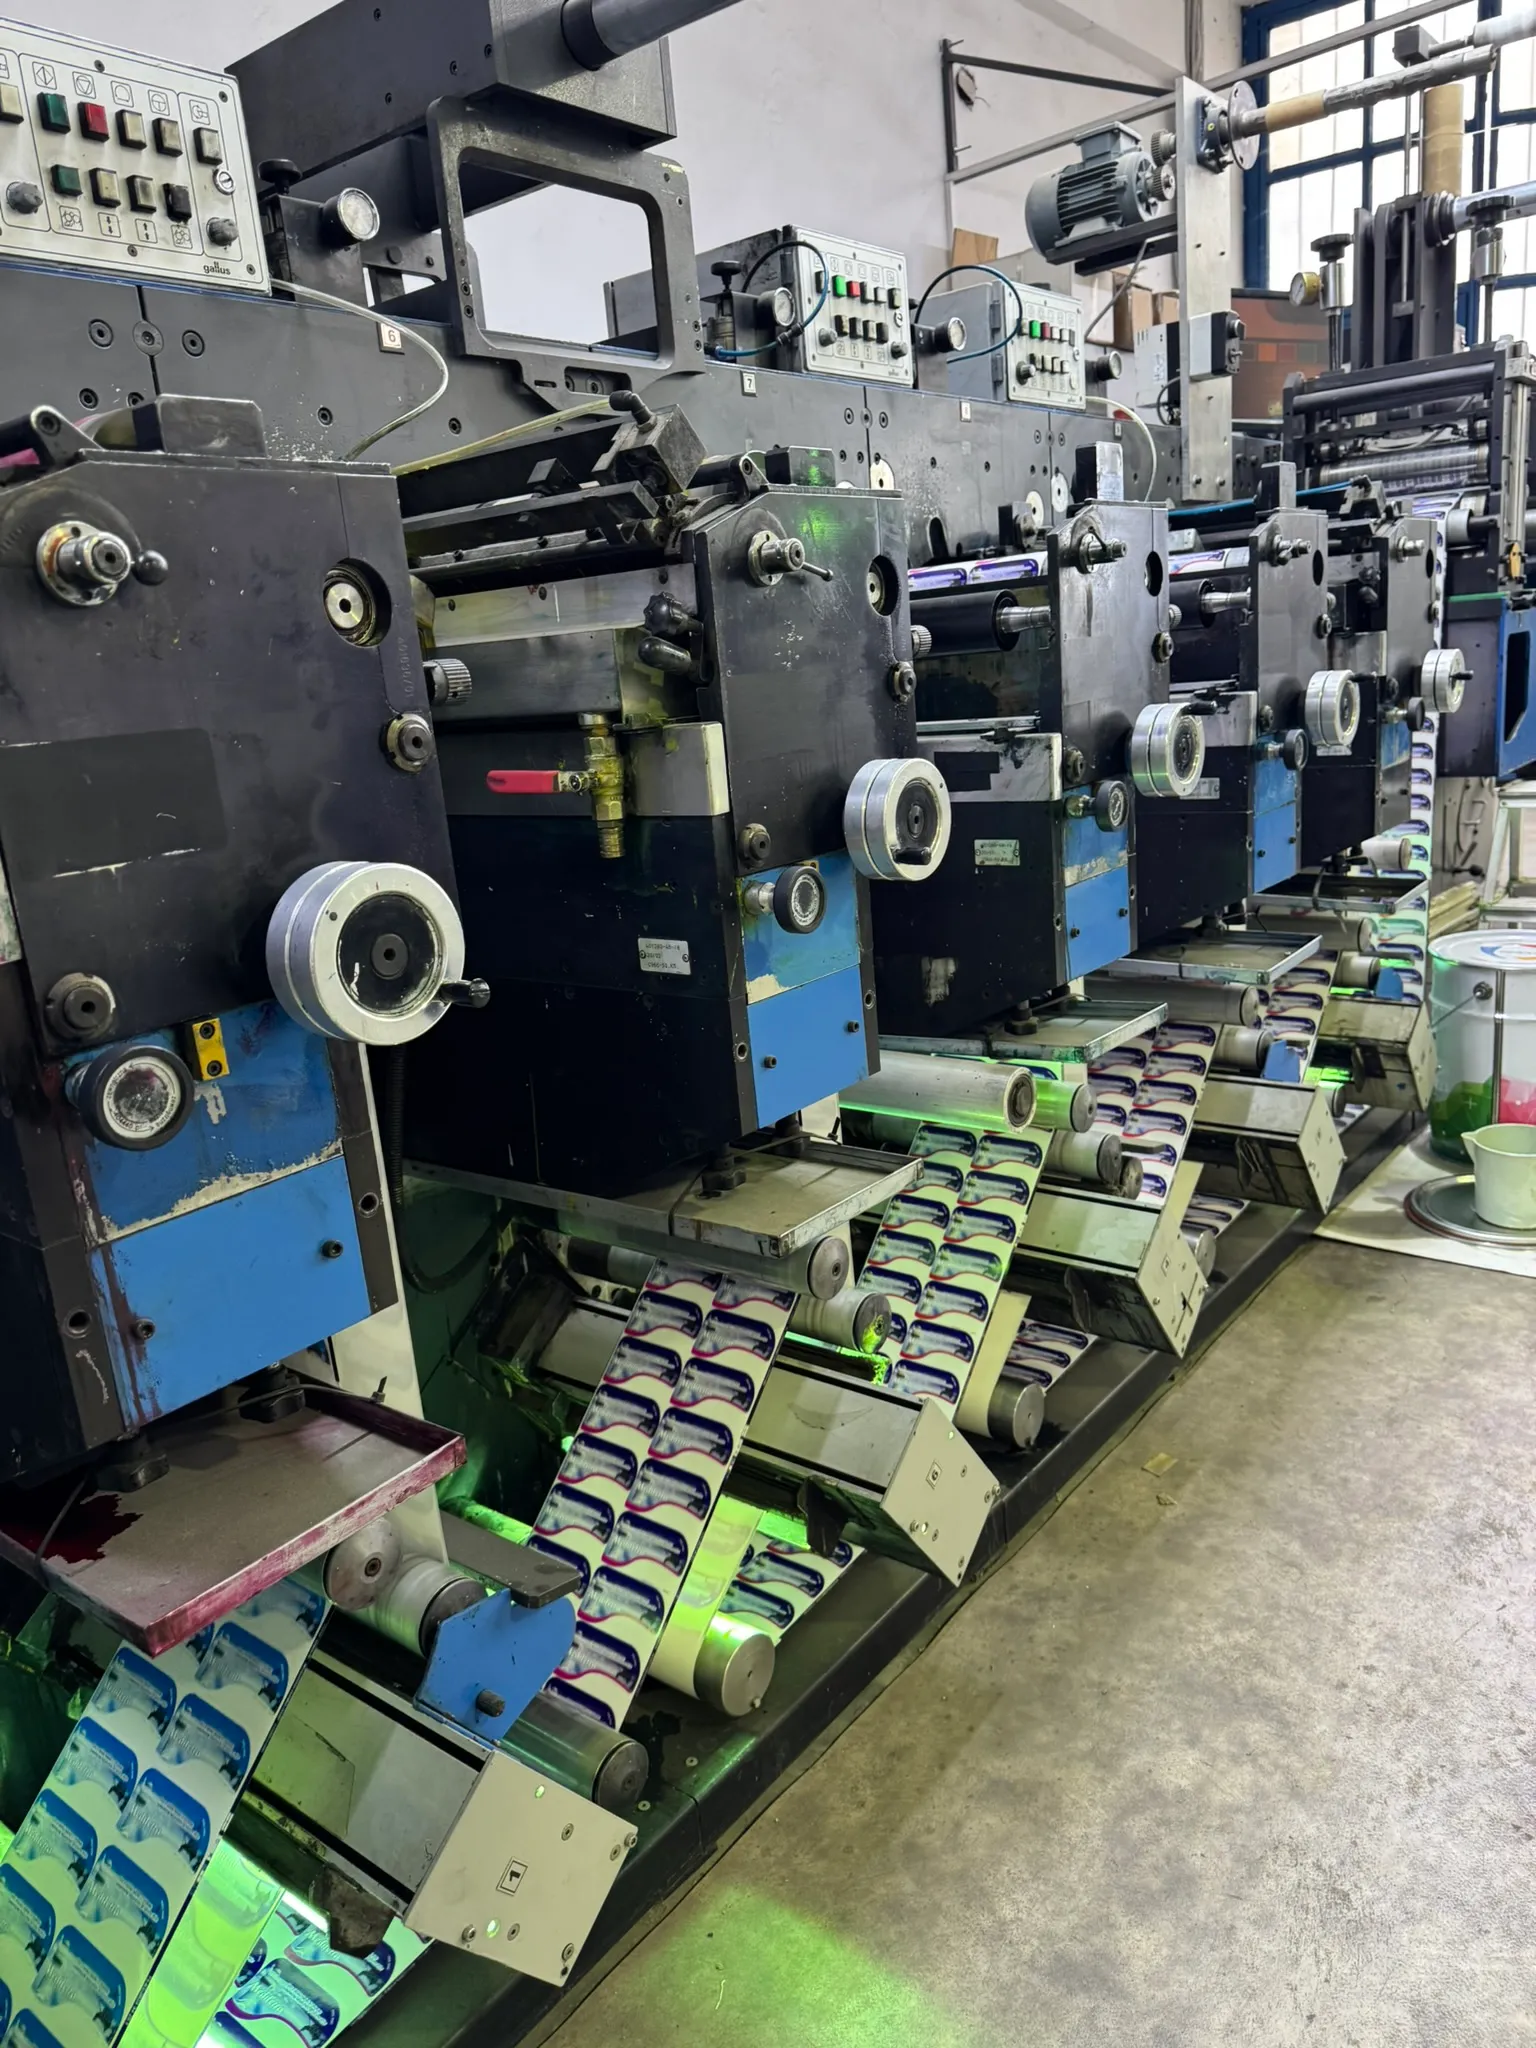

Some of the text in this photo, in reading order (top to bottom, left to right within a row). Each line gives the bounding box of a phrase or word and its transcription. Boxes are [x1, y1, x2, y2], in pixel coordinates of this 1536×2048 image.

[203, 261, 231, 275] gallus
[388, 329, 396, 343] 6
[746, 378, 753, 389] 7
[509, 1869, 521, 1882] 1
